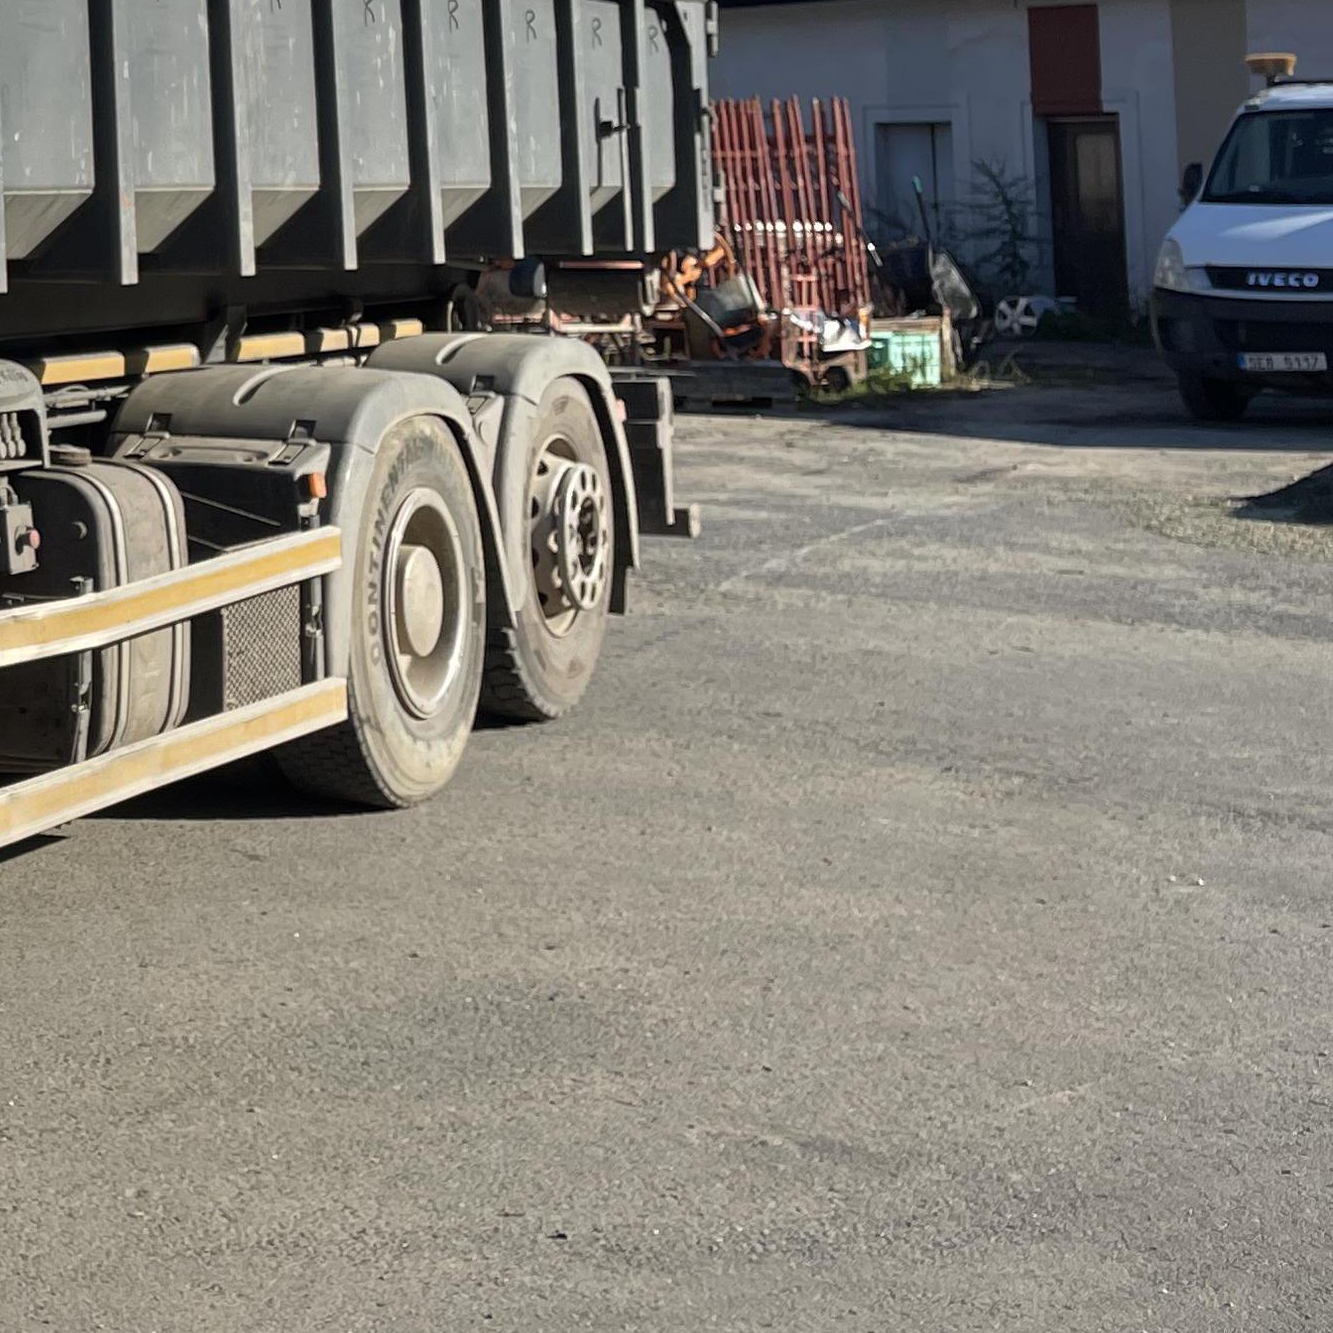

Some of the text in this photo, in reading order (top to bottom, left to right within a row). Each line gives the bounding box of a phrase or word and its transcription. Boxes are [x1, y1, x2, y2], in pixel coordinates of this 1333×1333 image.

[525, 9, 537, 43] R
[591, 17, 602, 50] R
[647, 25, 659, 57] R
[1247, 272, 1320, 287] IVECO
